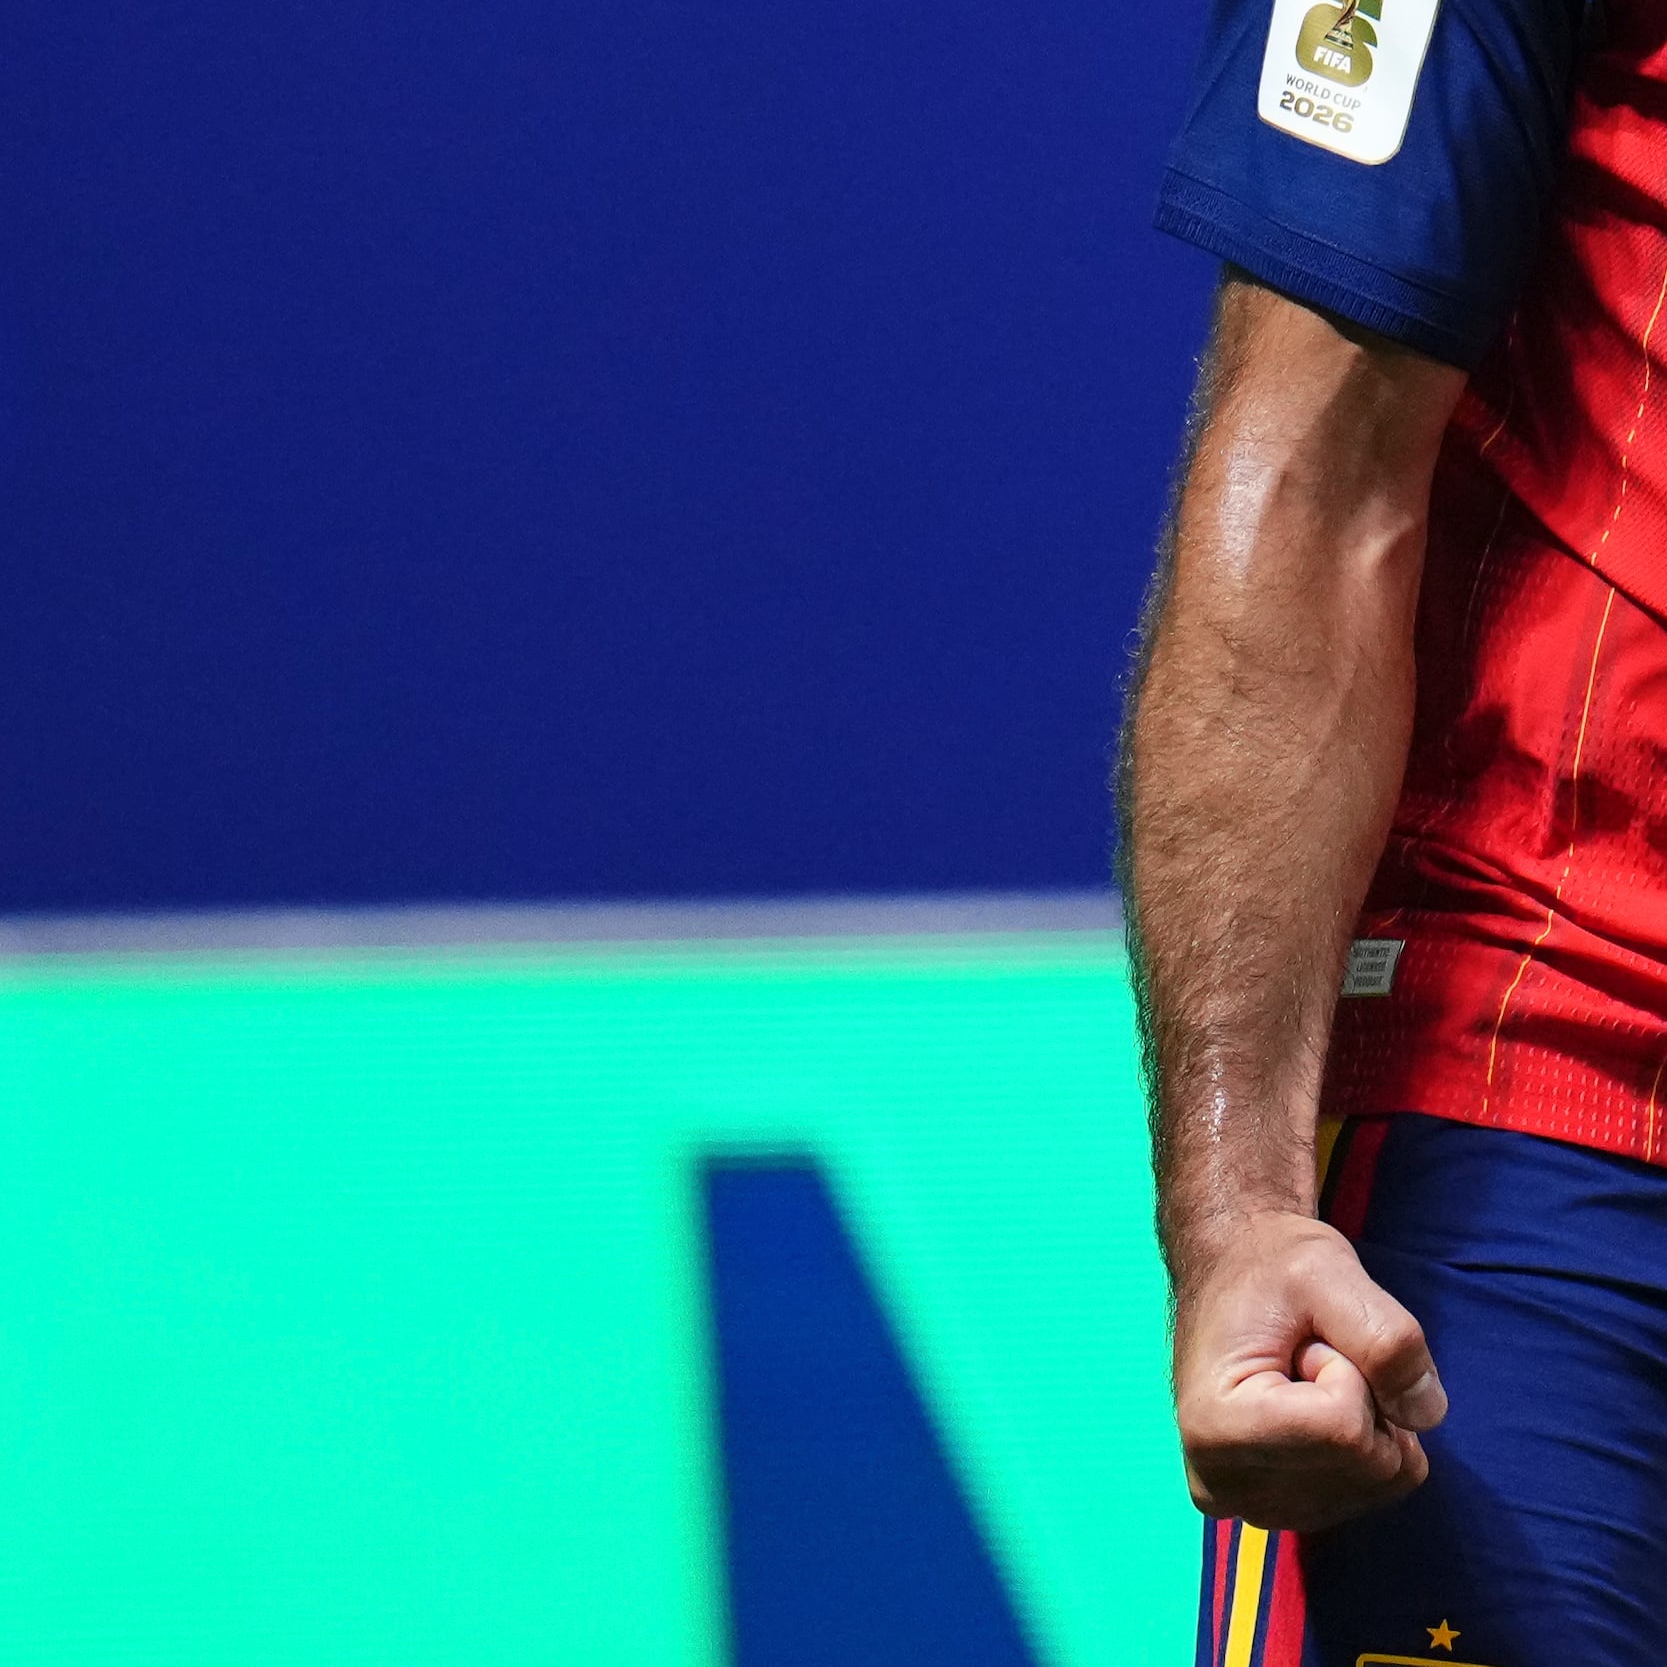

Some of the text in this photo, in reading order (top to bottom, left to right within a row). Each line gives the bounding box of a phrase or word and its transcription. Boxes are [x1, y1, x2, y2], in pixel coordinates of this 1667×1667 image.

[1313, 45, 1352, 74] FIFA
[1286, 73, 1361, 111] WORLD CUP
[1279, 89, 1354, 134] 2026
